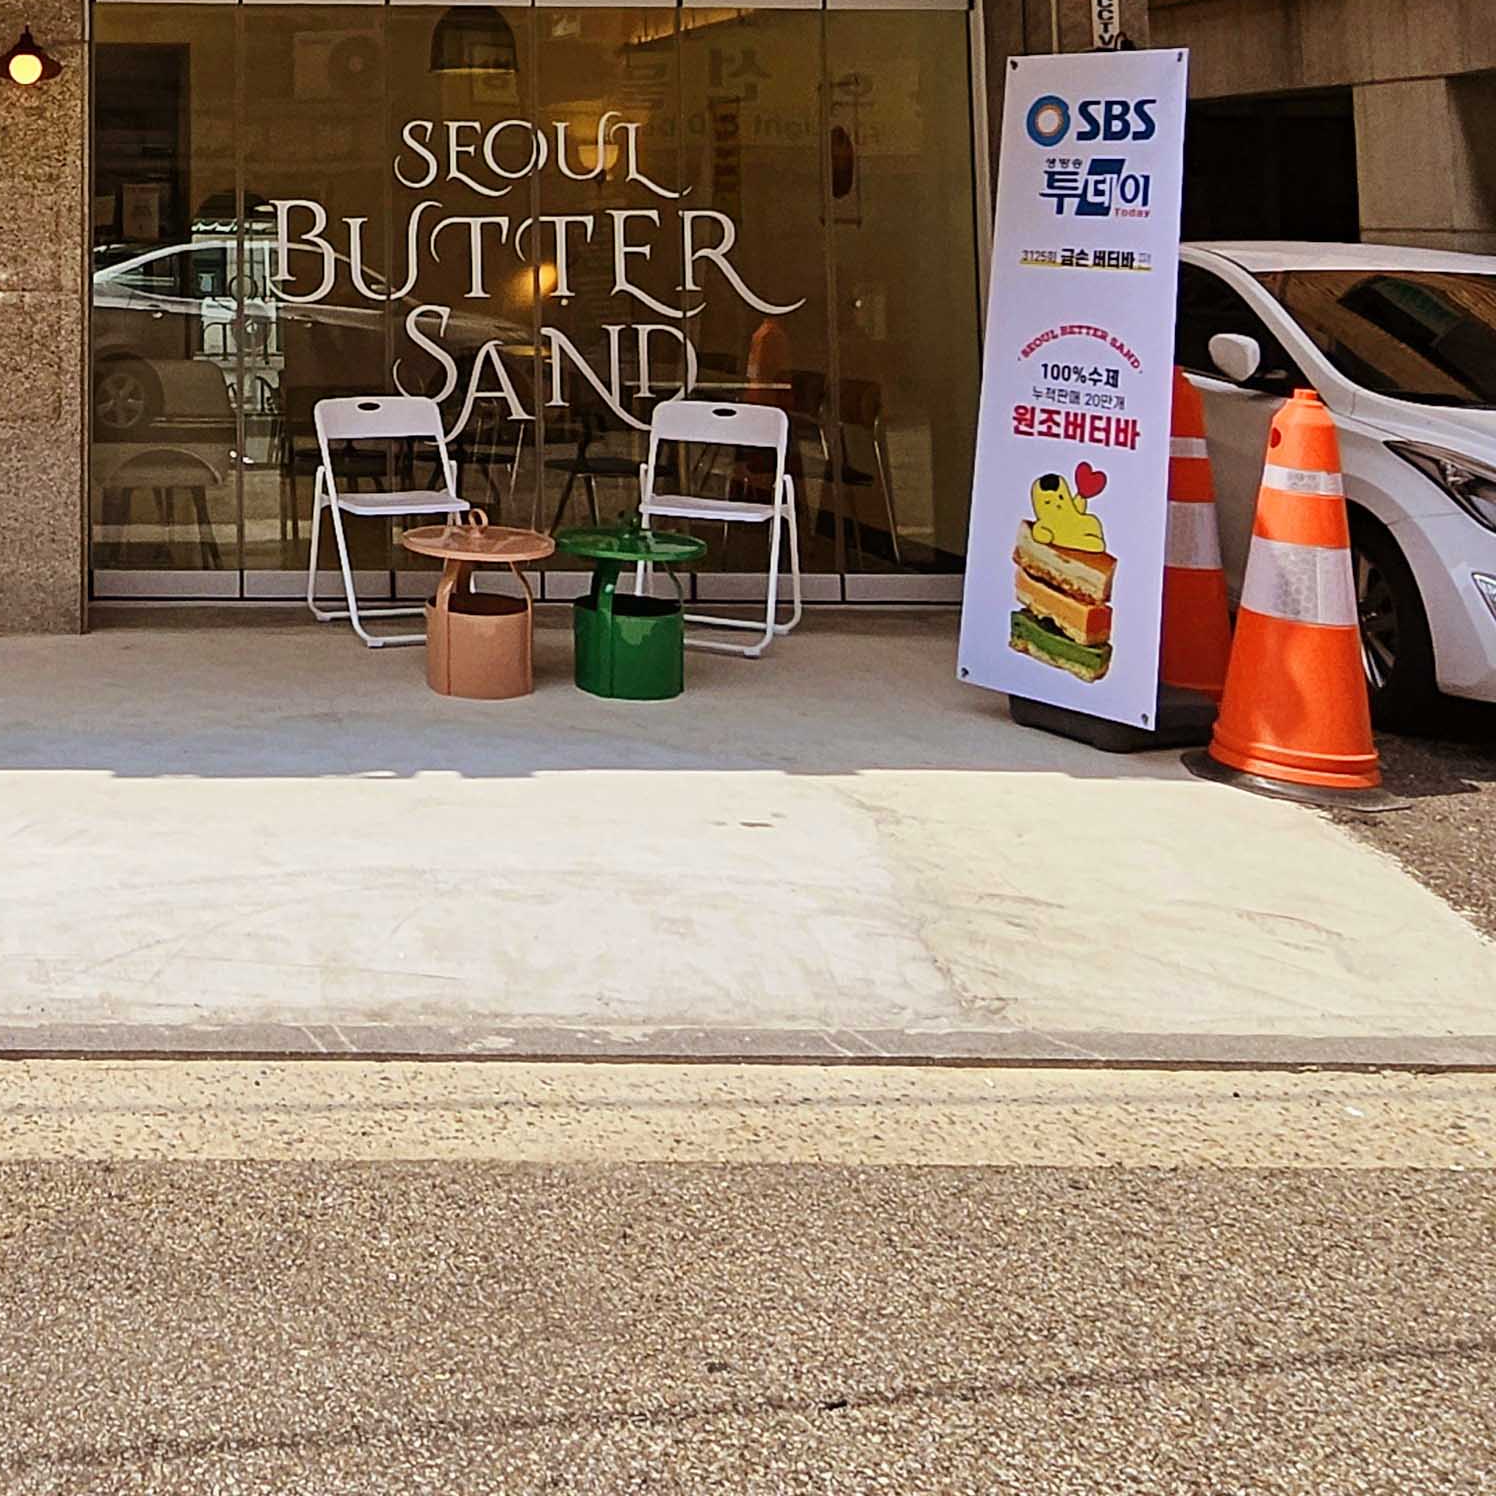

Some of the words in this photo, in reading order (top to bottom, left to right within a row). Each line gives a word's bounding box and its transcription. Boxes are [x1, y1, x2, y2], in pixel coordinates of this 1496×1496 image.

[1075, 98, 1158, 141] SBS
[394, 111, 693, 198] SEOUL
[1114, 207, 1151, 218] Today
[268, 199, 807, 319] BUTTER
[1060, 247, 1090, 267] 금손
[1092, 249, 1136, 270] 버터바
[393, 304, 698, 446] SAND
[1041, 363, 1120, 388] 100%수제
[1012, 404, 1141, 450] 원조버터바
